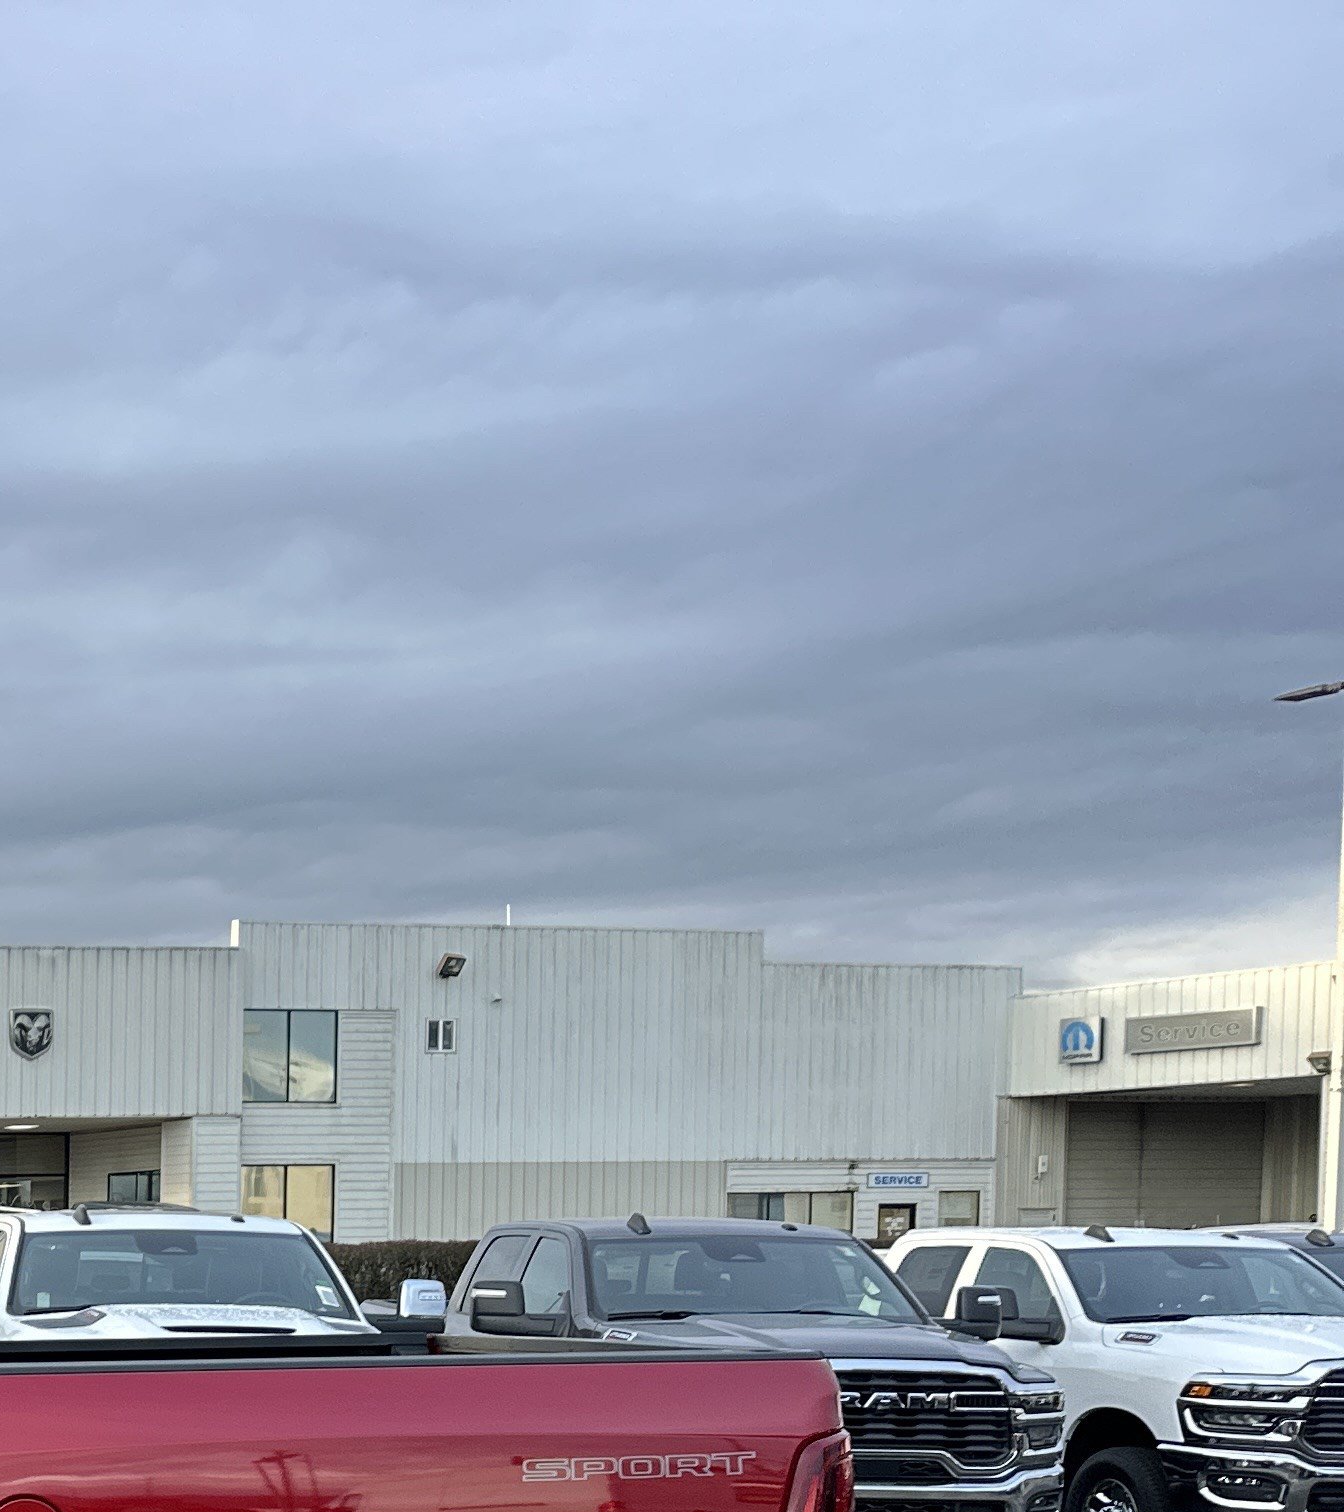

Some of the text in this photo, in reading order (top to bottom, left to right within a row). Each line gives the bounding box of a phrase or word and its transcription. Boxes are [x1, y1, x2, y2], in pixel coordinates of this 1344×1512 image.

[1140, 1021, 1241, 1043] Service
[874, 1175, 924, 1185] SERVICE
[839, 1391, 949, 1409] RAM
[521, 1451, 757, 1482] SPORT
